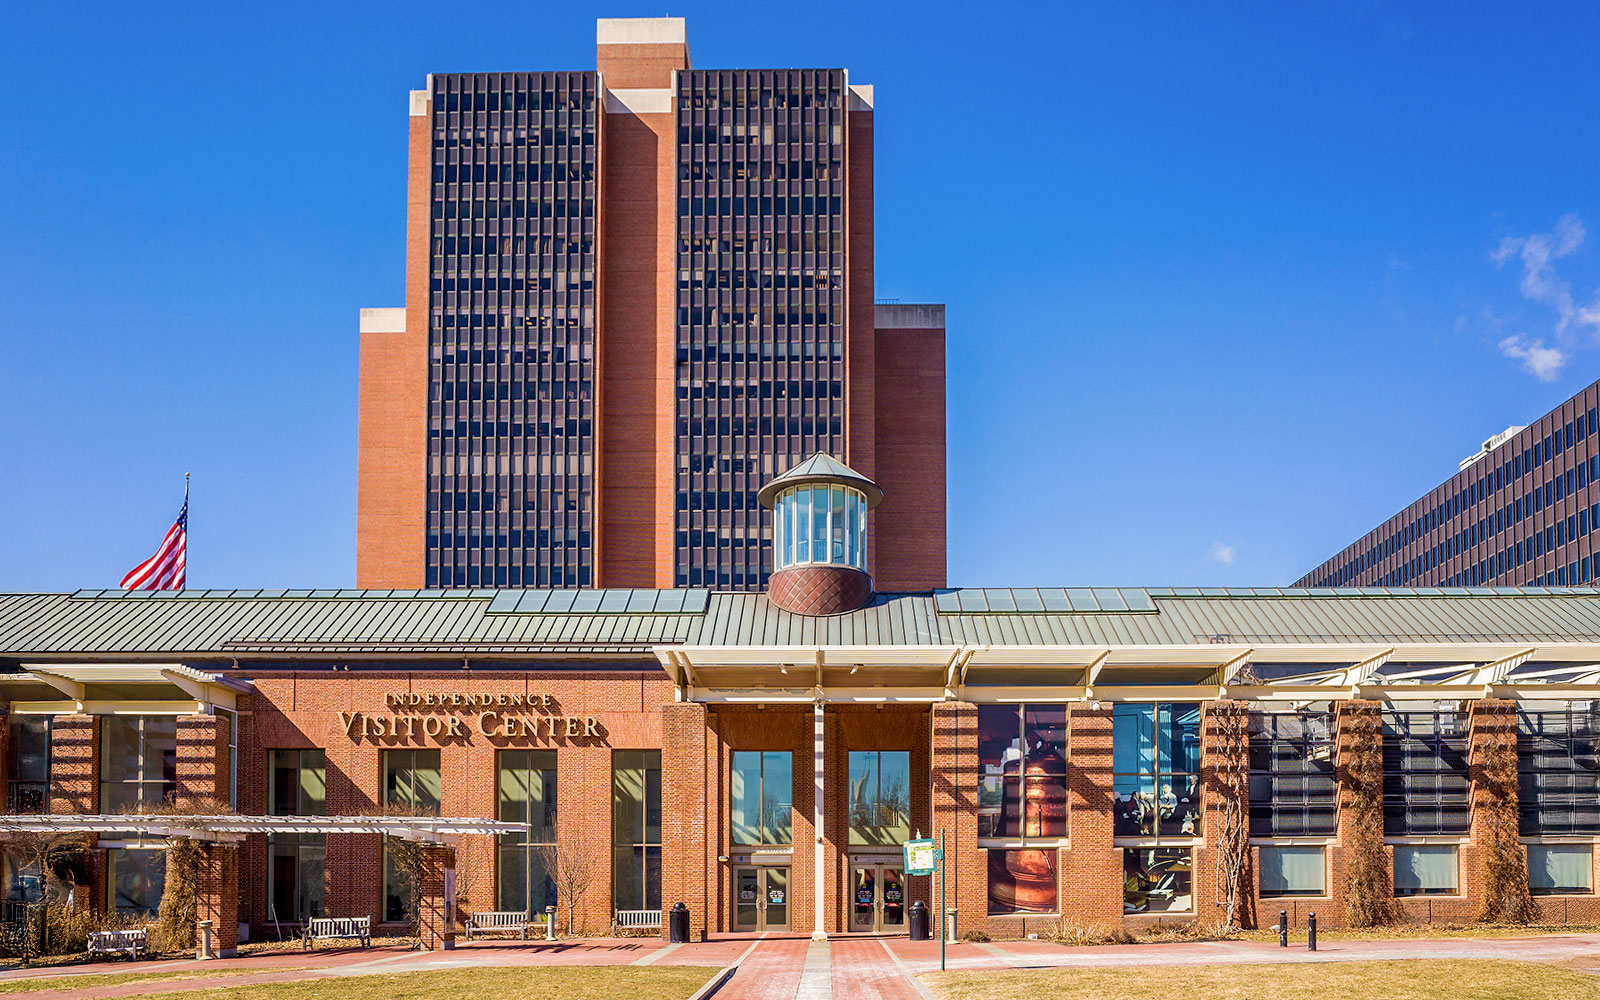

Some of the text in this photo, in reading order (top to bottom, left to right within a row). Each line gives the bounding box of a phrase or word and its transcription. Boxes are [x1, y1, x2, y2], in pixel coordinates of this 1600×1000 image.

[384, 692, 552, 706] INDEPENDENCE
[336, 711, 600, 737] VISITOR CENTER
